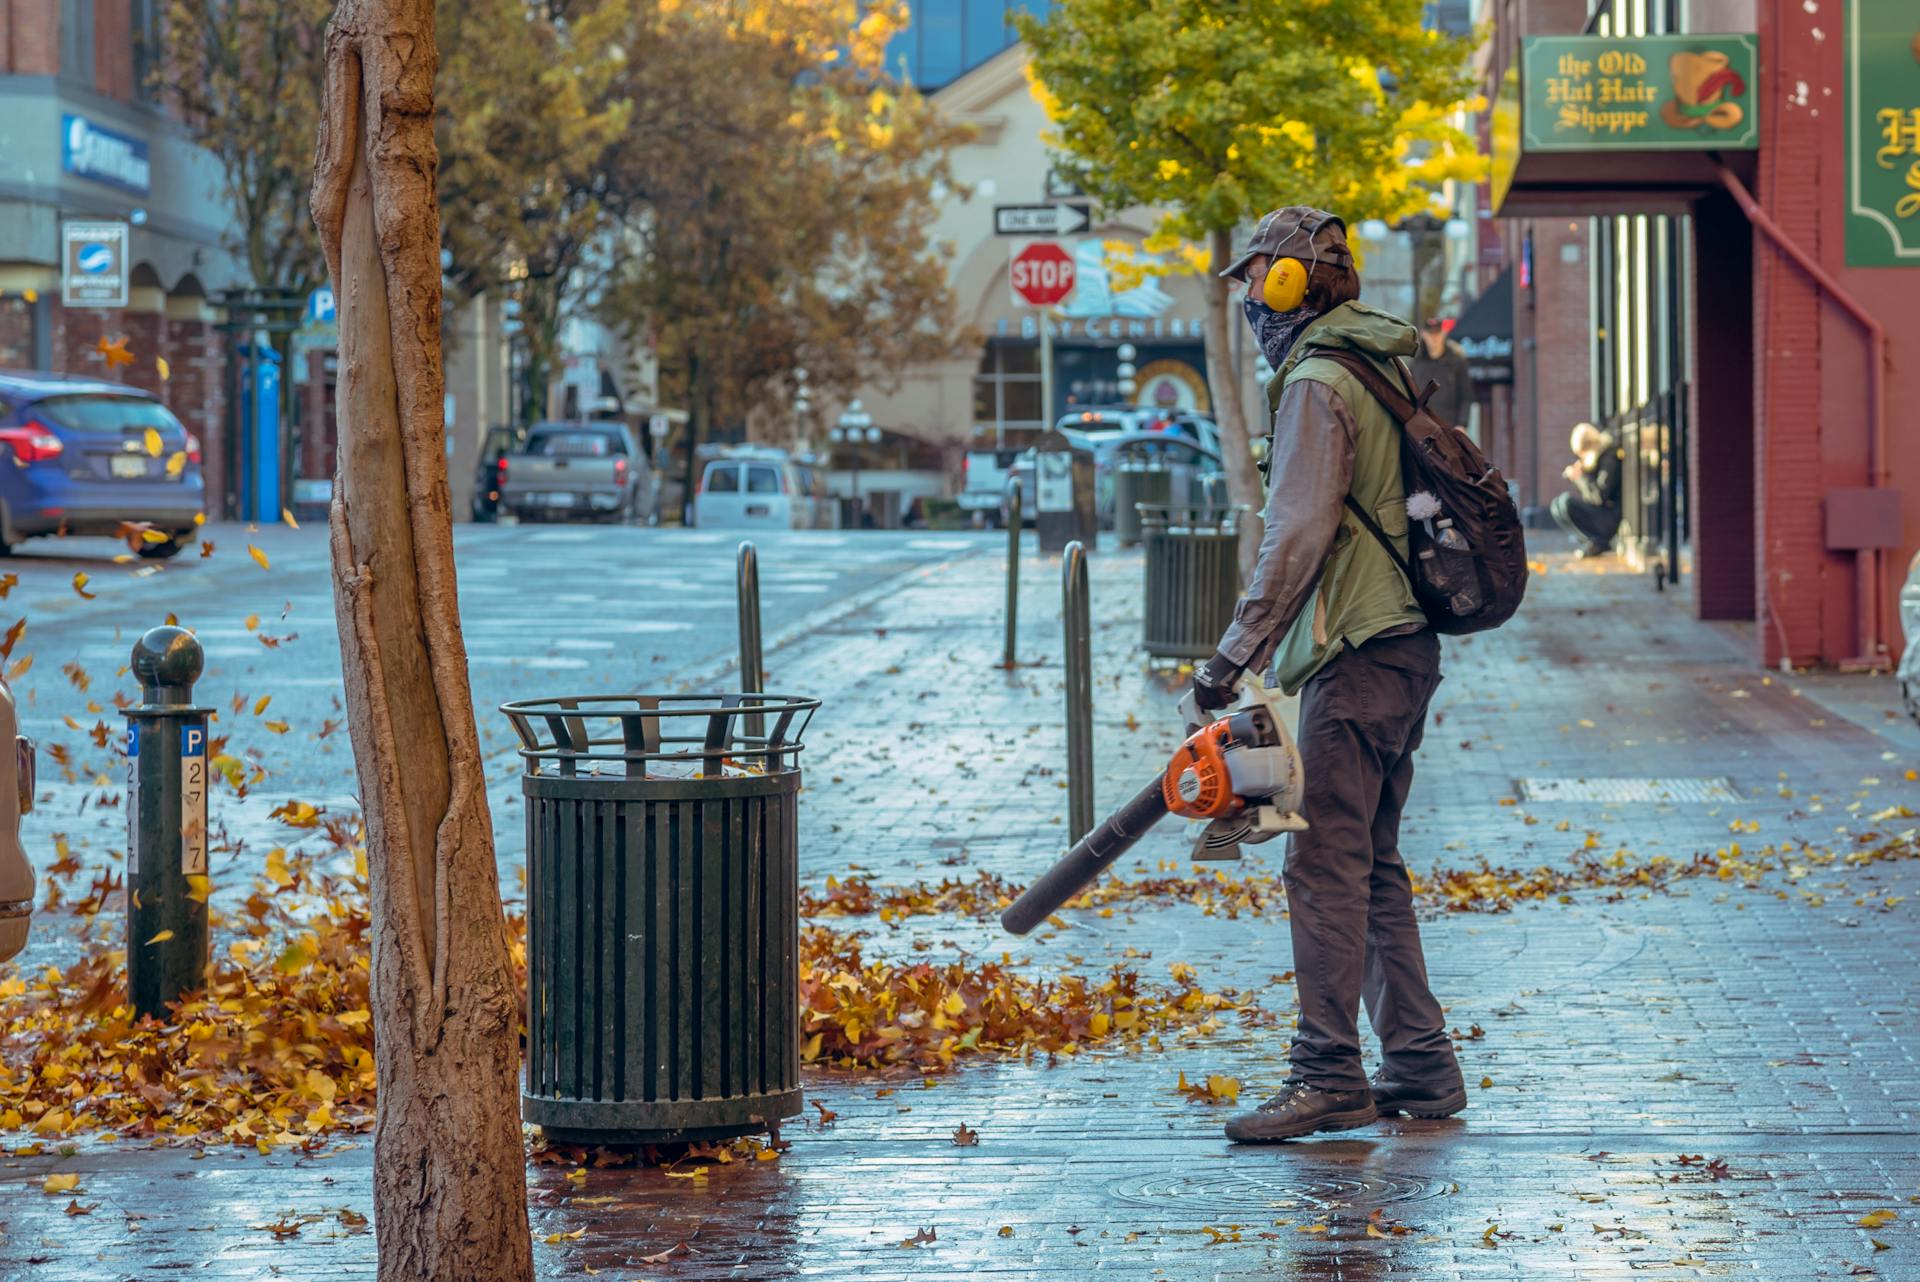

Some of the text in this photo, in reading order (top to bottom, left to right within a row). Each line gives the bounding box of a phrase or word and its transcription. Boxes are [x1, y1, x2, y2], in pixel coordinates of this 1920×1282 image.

[1558, 50, 1647, 81] the Old
[1545, 78, 1657, 107] Hat Hair
[1553, 103, 1649, 134] Shoppe
[1004, 213, 1030, 225] ONE
[1013, 260, 1073, 288] STOP
[315, 290, 334, 319] P
[1085, 315, 1201, 338] CENTRE
[188, 730, 202, 753] P
